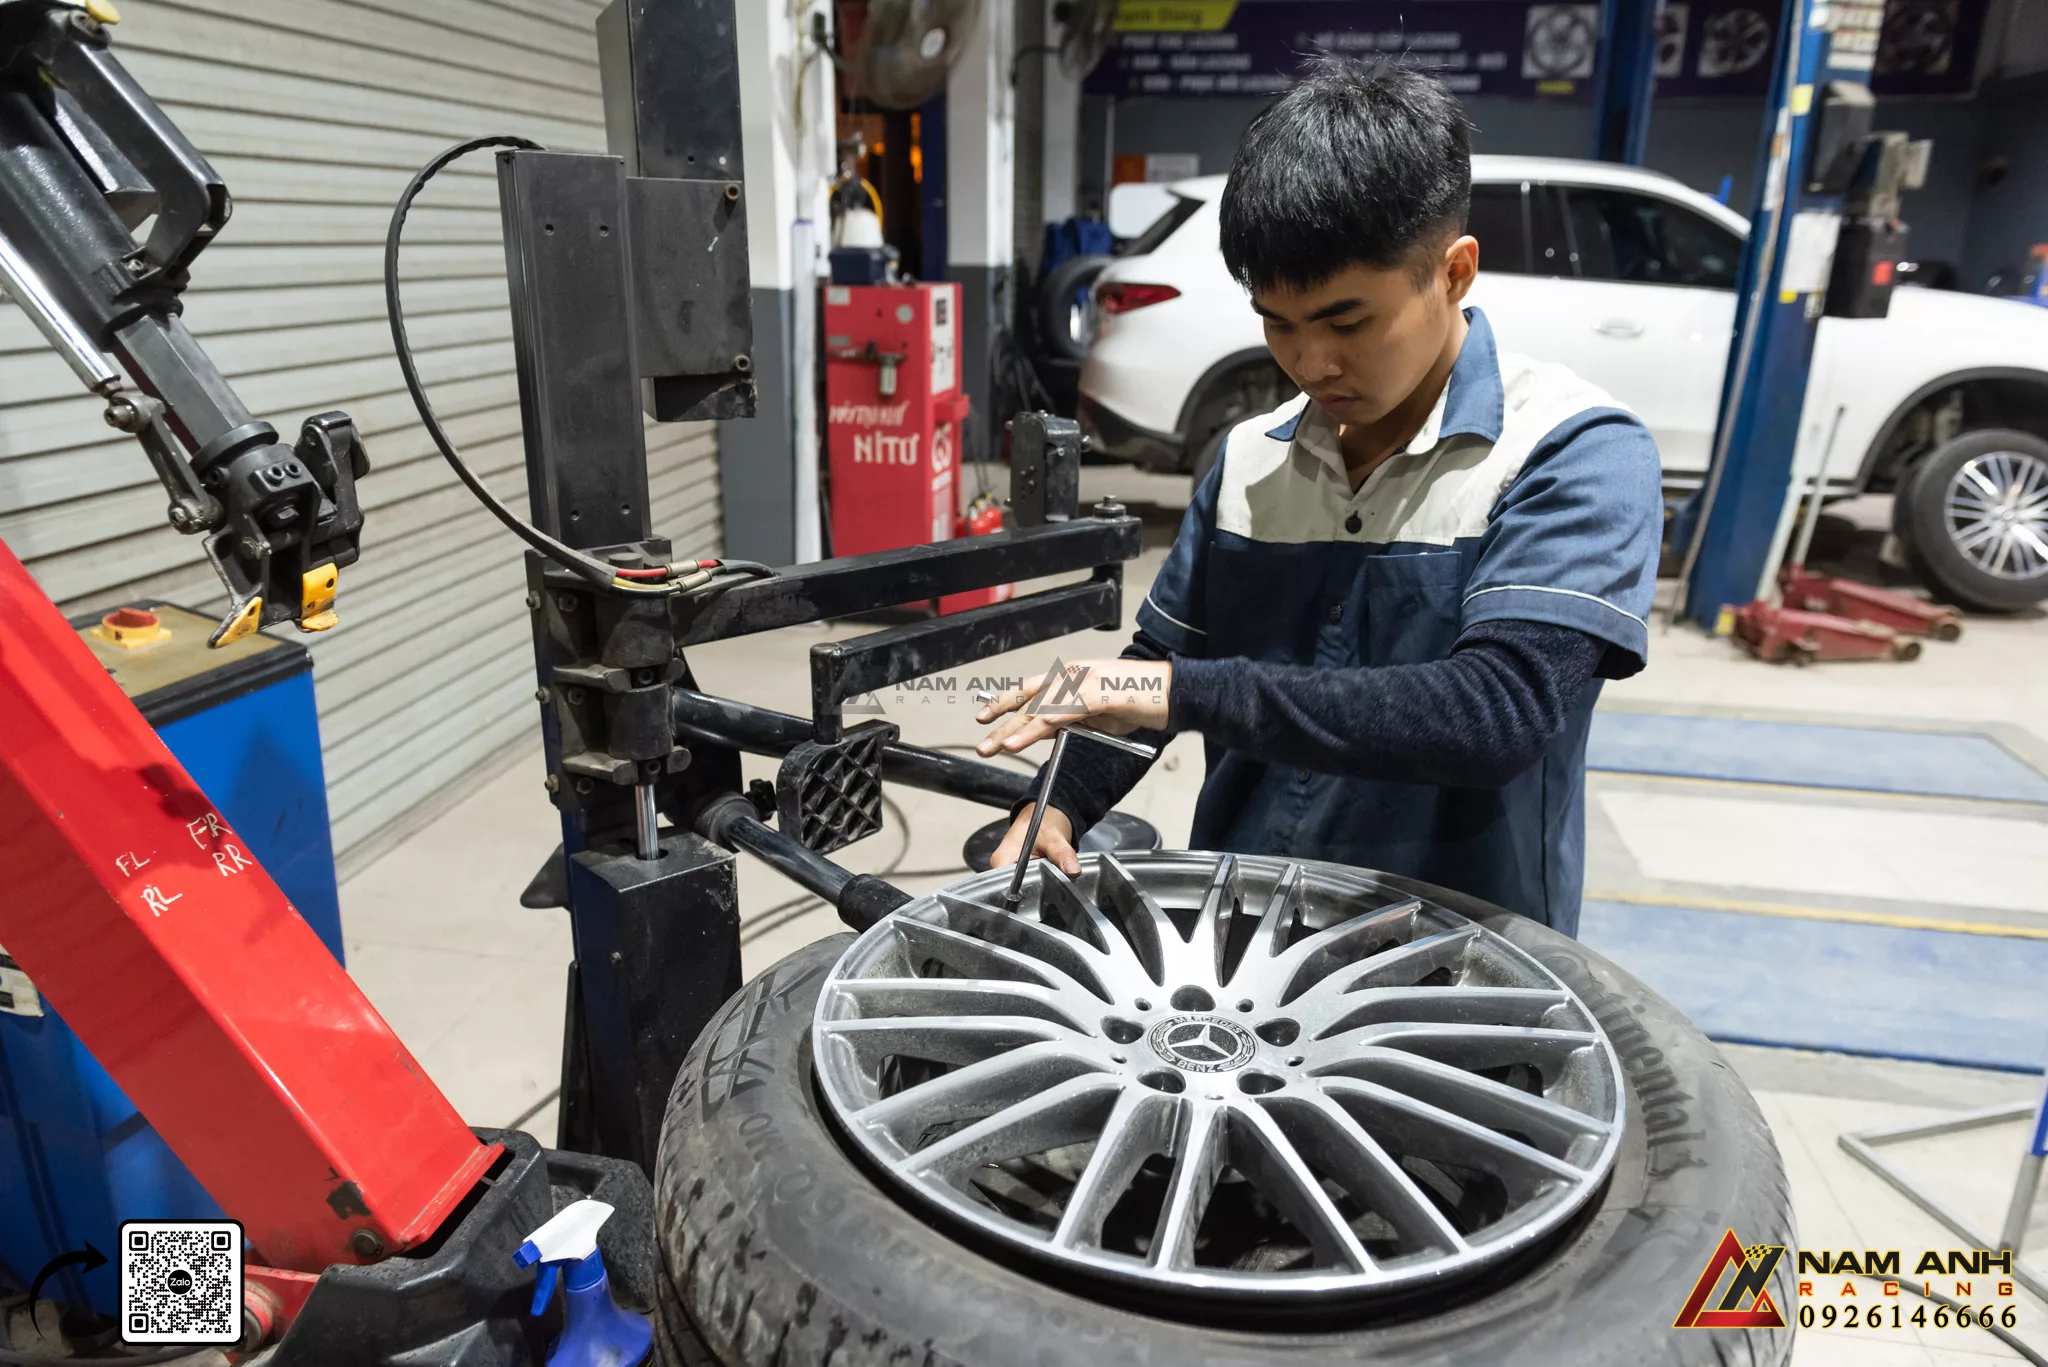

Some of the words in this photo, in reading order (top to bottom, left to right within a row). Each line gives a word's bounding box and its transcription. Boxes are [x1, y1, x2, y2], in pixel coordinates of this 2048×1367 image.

[186, 812, 233, 850] FR
[115, 851, 151, 878] FL
[212, 843, 253, 877] RR
[140, 885, 184, 917] RL
[1176, 1060, 1216, 1073] BENZ
